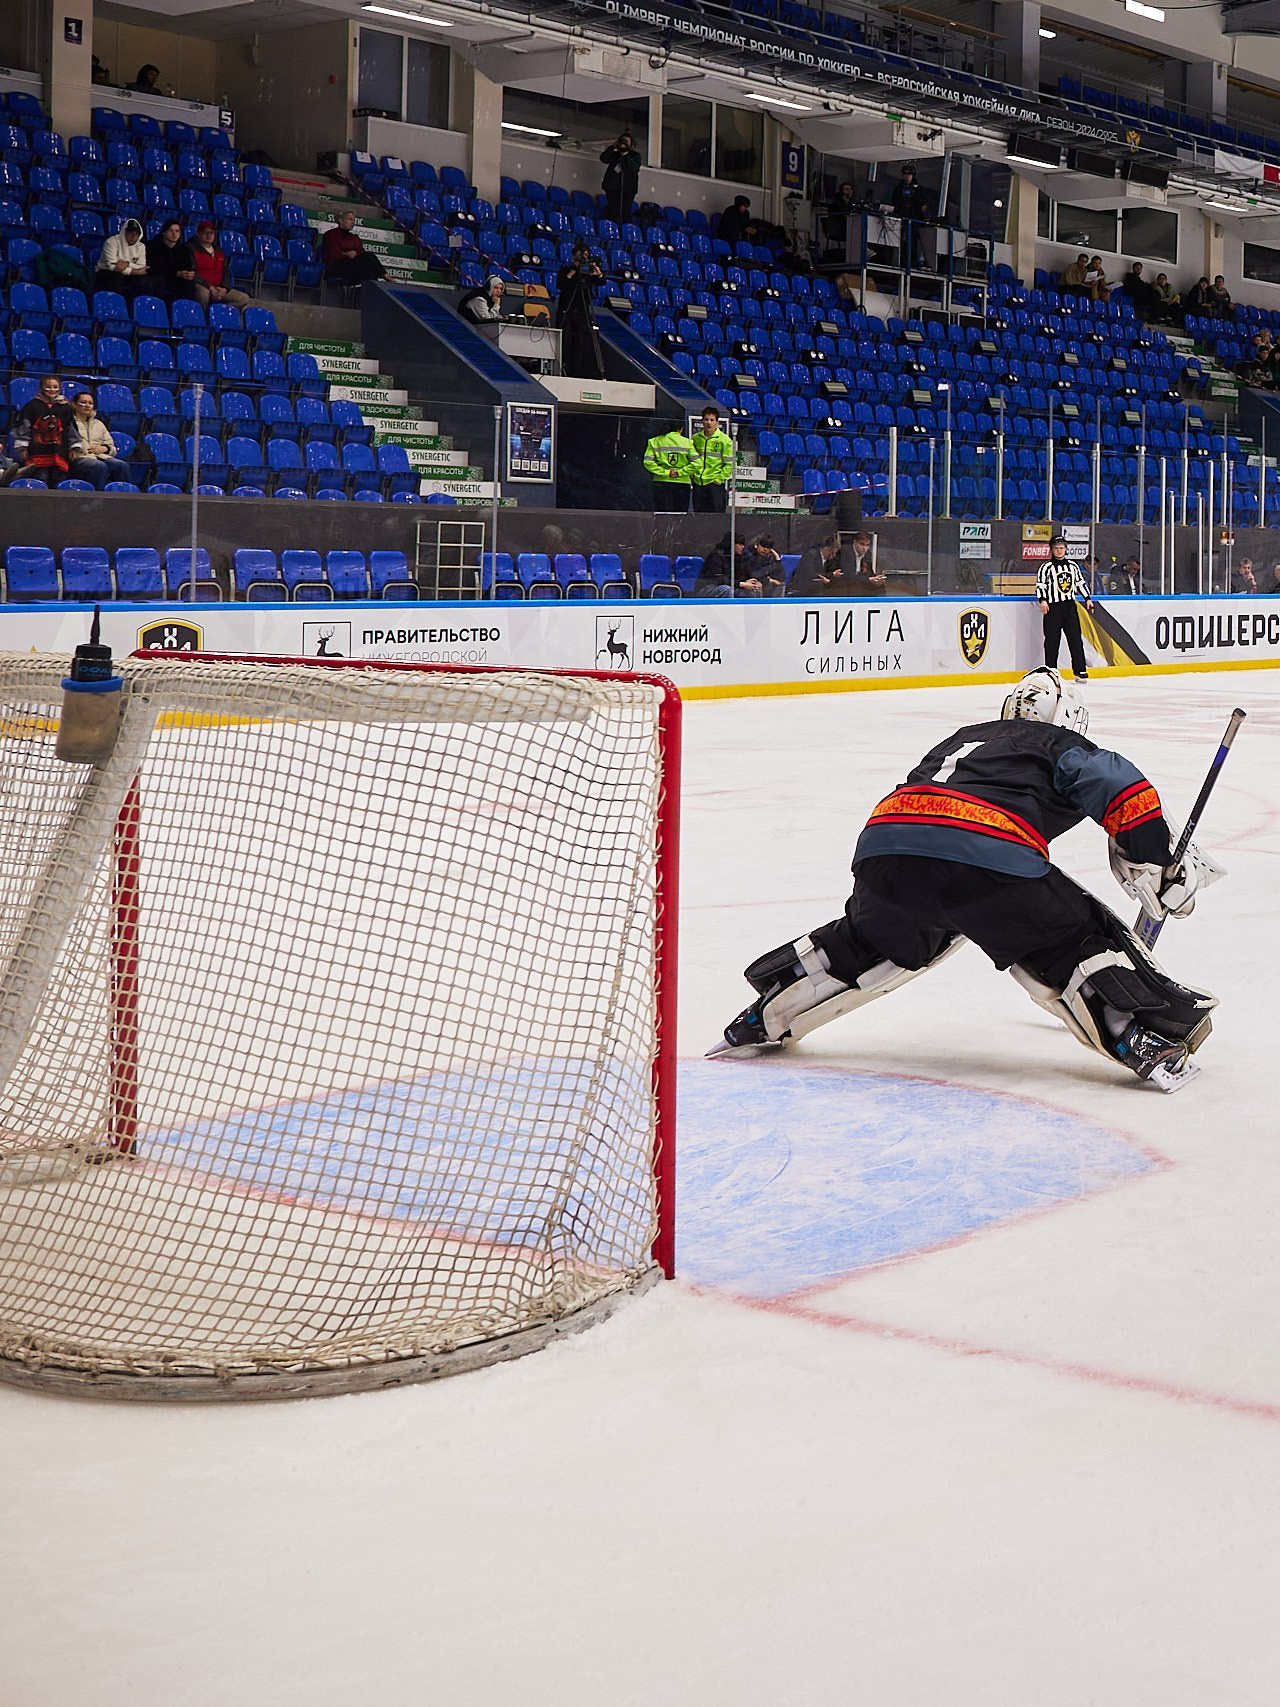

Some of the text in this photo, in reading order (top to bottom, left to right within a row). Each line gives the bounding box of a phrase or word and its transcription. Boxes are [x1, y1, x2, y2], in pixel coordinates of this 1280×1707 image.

[68, 22, 78, 37] 1
[674, 18, 747, 48] ЧЕМПИОНАТ
[750, 39, 795, 60] РОССИИ
[798, 51, 814, 66] ПО
[817, 56, 860, 76] ХОККЕЮ
[877, 71, 960, 101] ВСЕРОССИЙСКАЯ
[221, 110, 232, 126] 5
[788, 151, 798, 172] 9
[299, 342, 346, 353] ДЛЯ ЧИСТОТЫ
[322, 359, 361, 371] SYNERGETIC
[326, 373, 372, 383] ДЛЯ КРАСОТЫ
[350, 389, 389, 402] SYNERGETIC
[366, 405, 401, 415] ЗДОРОВЬЯ
[380, 421, 419, 431] SYNERGETIC
[387, 436, 434, 445] ДЛЯ ЧИСТОТЫ
[412, 452, 451, 462] SYNERGETIC
[433, 467, 464, 476] КРАСОТЫ
[443, 484, 482, 494] SYNERGETIC
[962, 526, 989, 536] PARI
[1022, 546, 1050, 556] FONBET
[800, 609, 905, 645] ЛИГА
[362, 627, 501, 645] ПРАВИТЕЛЬСТВО
[642, 624, 709, 643] НИЖНИЙ
[642, 648, 722, 665] НОВГОРОД
[805, 654, 902, 675] СИЛЬНЫХ
[931, 741, 987, 784] 1
